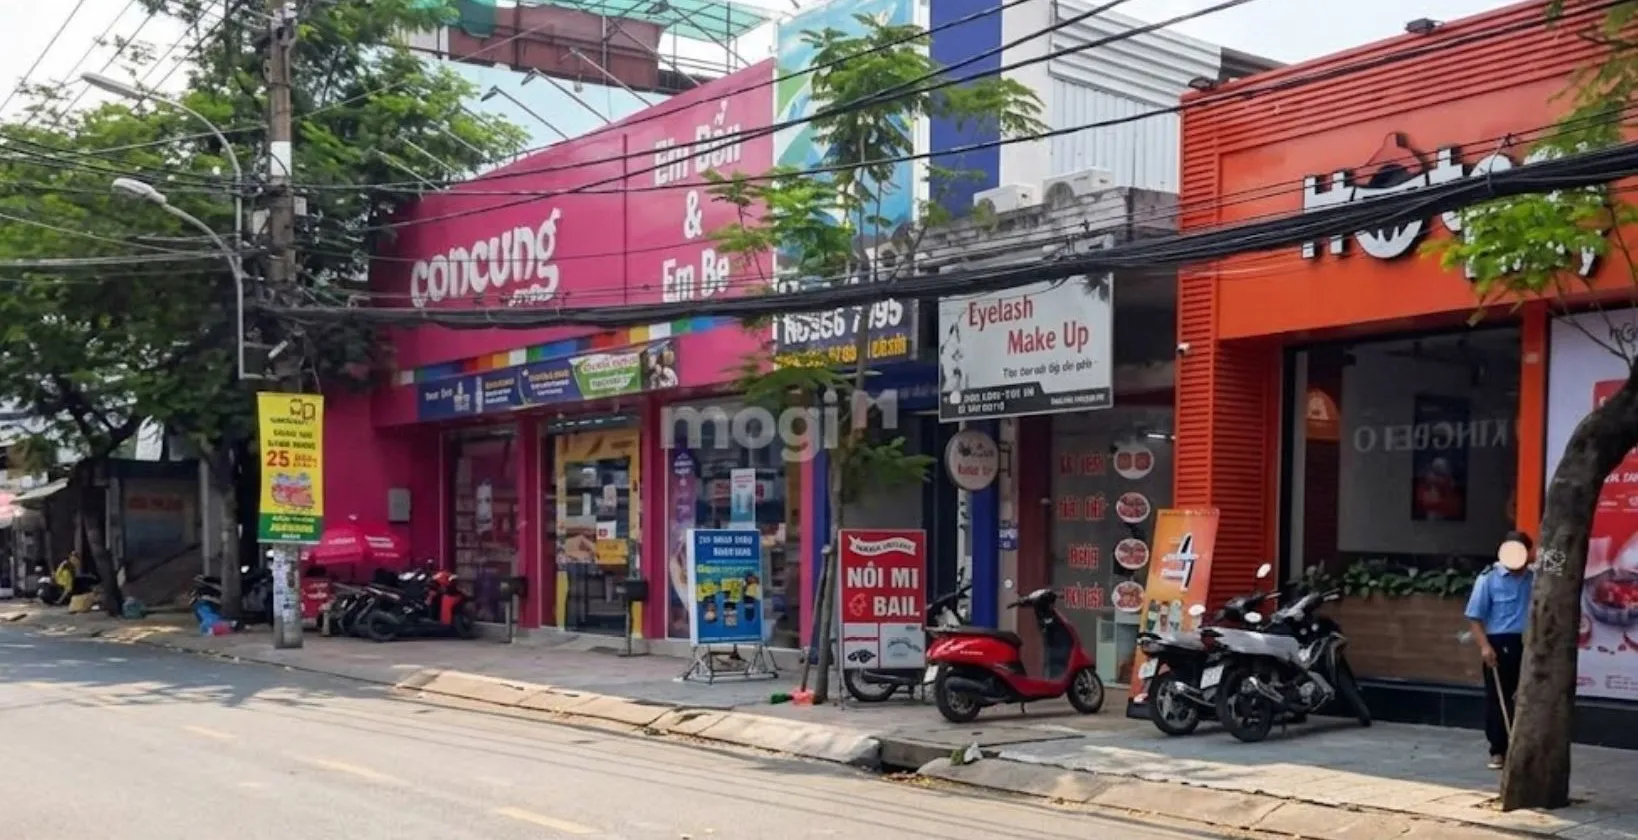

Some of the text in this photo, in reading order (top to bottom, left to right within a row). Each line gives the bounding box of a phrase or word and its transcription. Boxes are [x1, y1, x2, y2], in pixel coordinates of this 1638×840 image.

[662, 257, 695, 303] Em
[968, 294, 1034, 332] Eyelash
[1007, 321, 1090, 355] Make Up
[266, 450, 290, 468] 25
